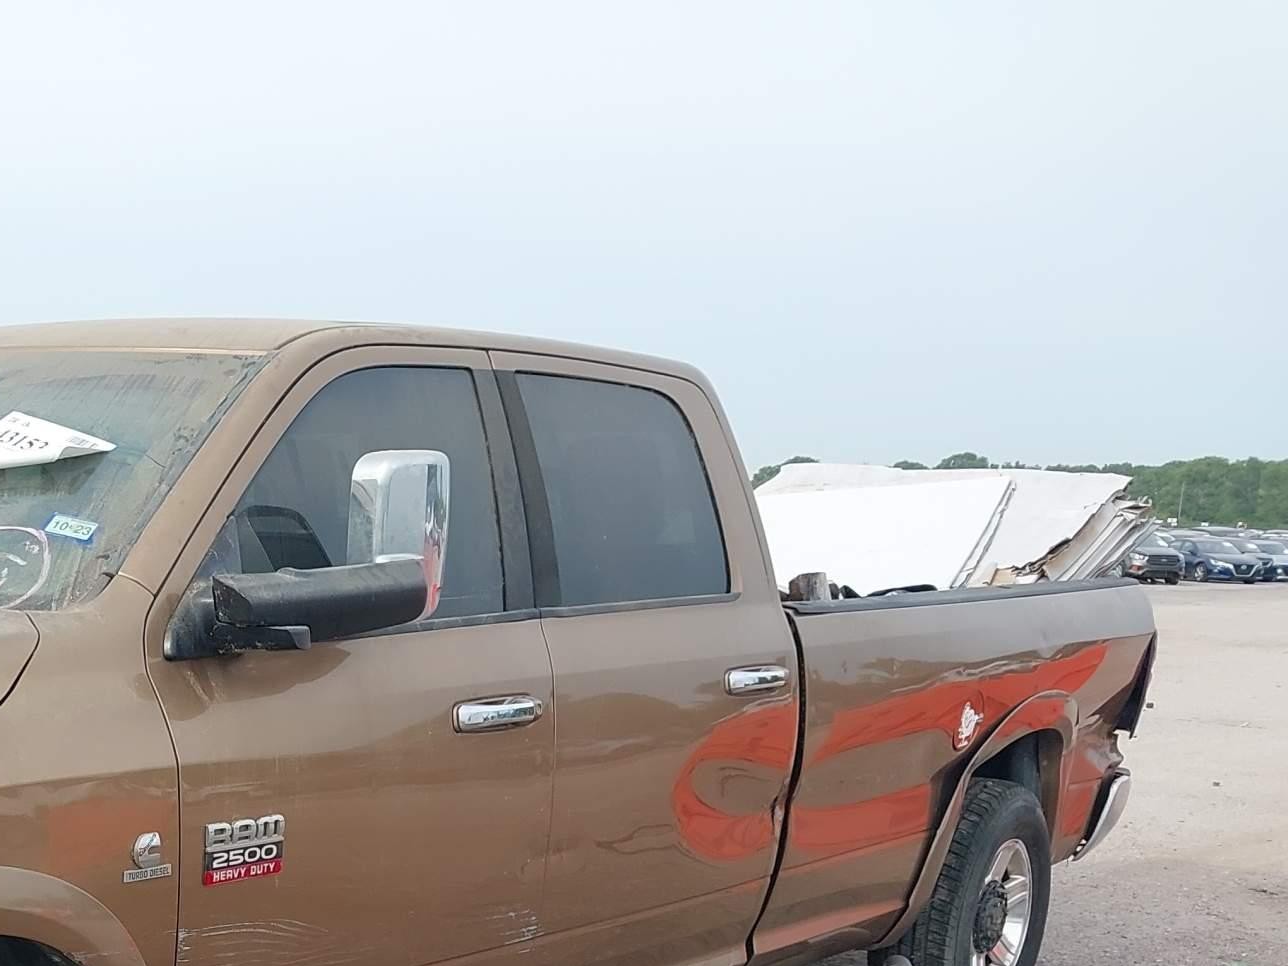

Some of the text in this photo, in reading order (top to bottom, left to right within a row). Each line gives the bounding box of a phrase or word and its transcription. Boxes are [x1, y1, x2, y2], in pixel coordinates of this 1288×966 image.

[205, 814, 285, 848] RAM
[212, 844, 278, 869] 2500
[128, 866, 169, 880] TURBO DIESEL
[212, 862, 276, 883] HEAVY DUTY
